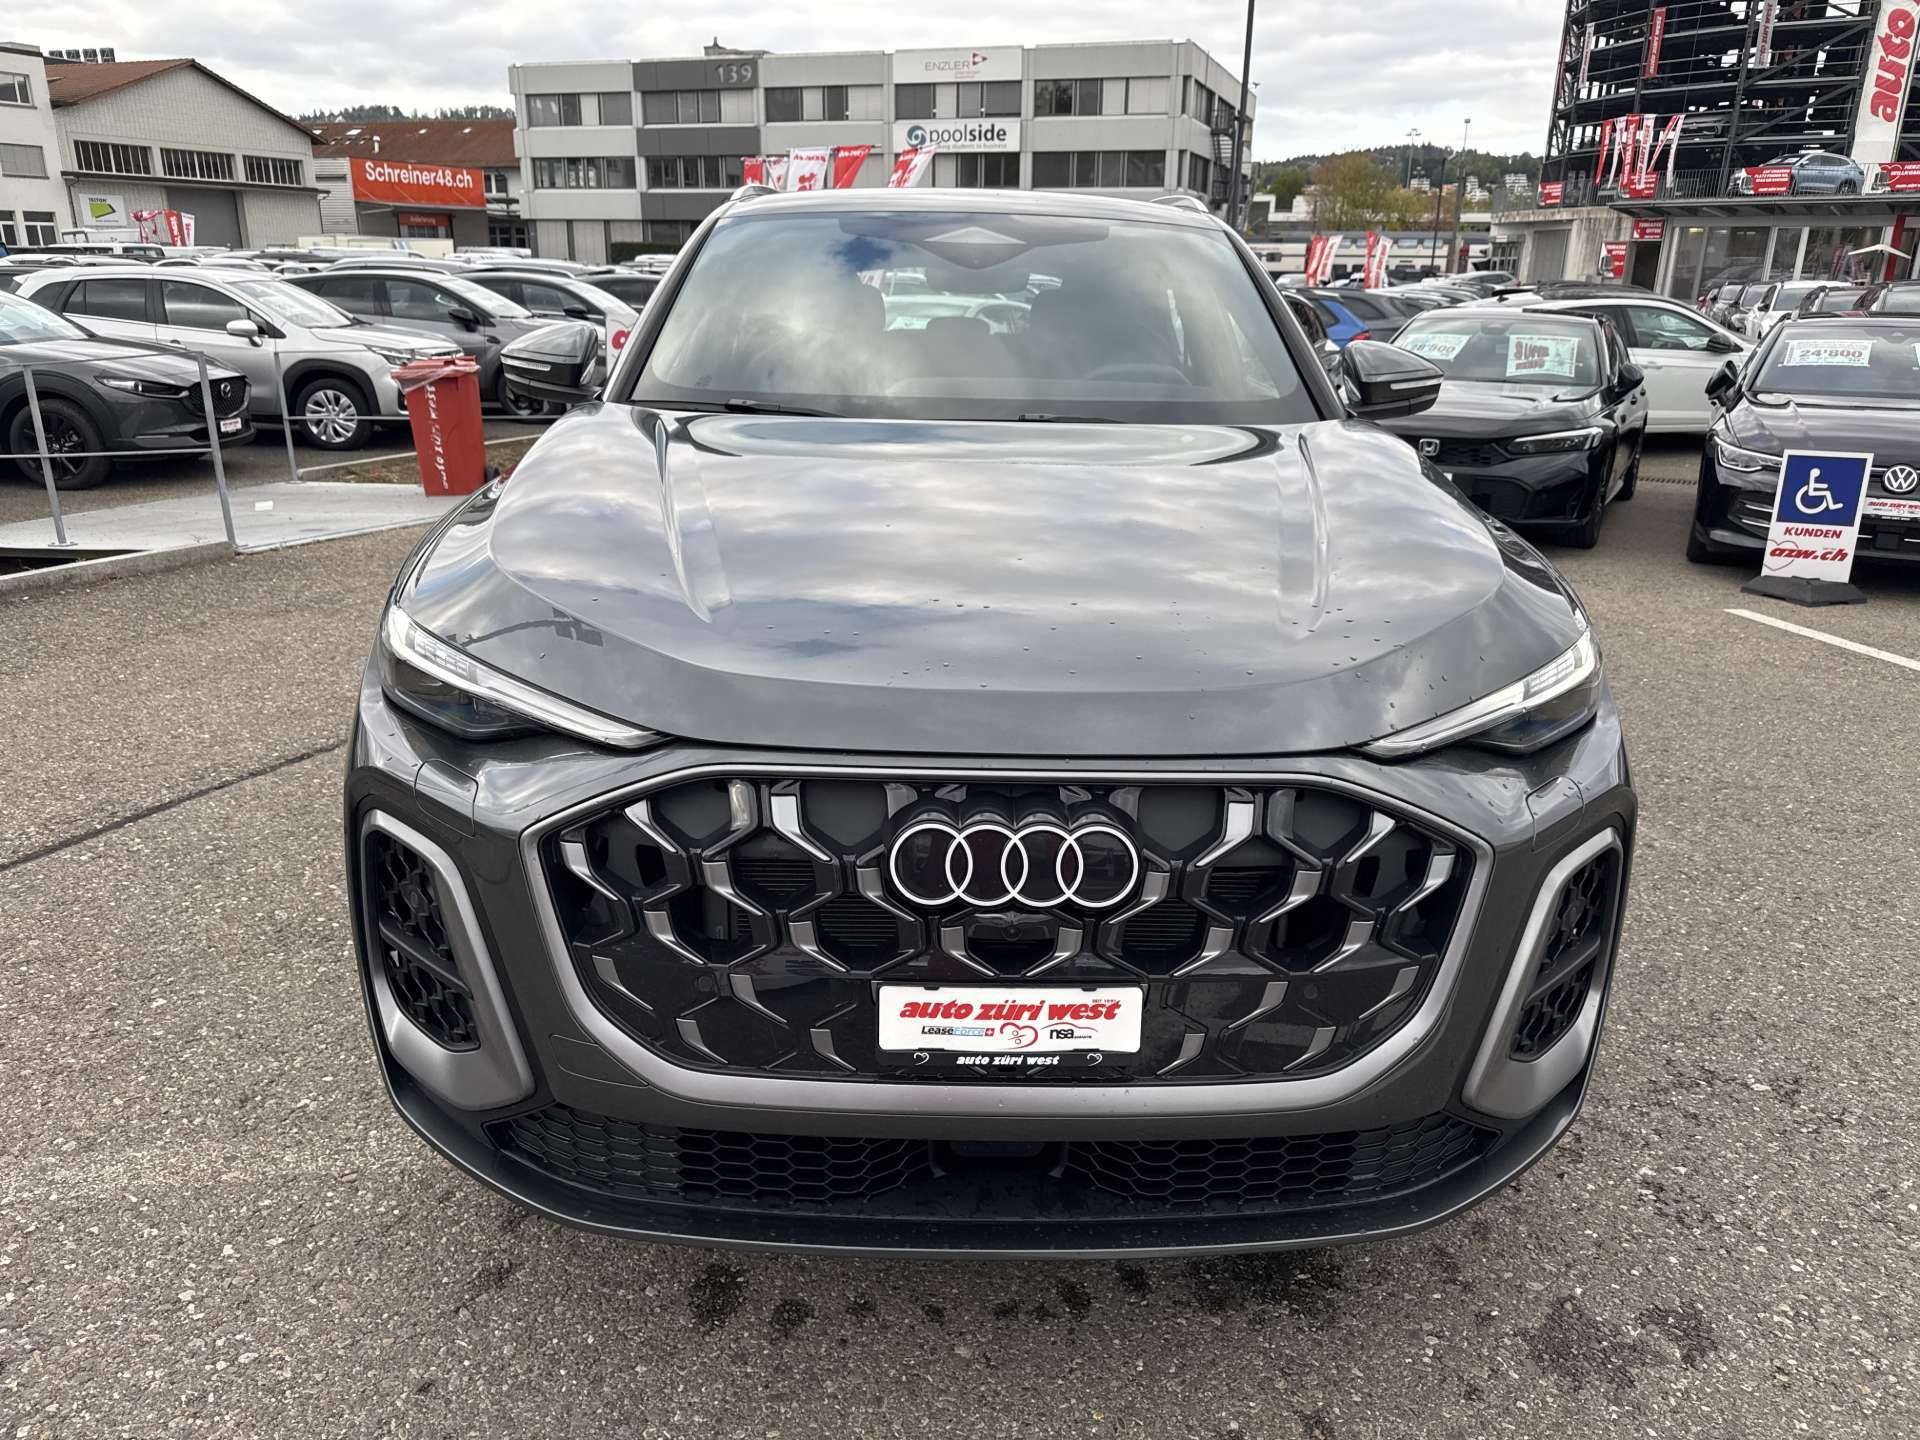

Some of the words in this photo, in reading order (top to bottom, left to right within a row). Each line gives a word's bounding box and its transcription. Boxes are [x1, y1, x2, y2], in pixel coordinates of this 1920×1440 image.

[924, 61, 971, 72] ENZLER
[1870, 8, 1916, 123] auto
[717, 63, 752, 83] 139
[929, 123, 1007, 144] poolside
[365, 161, 473, 189] Schreiner48.ch
[1800, 348, 1863, 358] 24'800
[1784, 526, 1843, 539] KUNDEN
[1770, 546, 1849, 562] azw.ch
[900, 999, 973, 1021] auto
[974, 1000, 1046, 1021] züri
[1048, 999, 1122, 1021] west
[921, 1025, 985, 1036] LeaseForce
[1049, 1028, 1074, 1039] nsa
[956, 1055, 989, 1065] auto
[992, 1054, 1024, 1065] züri
[1026, 1055, 1060, 1065] west
